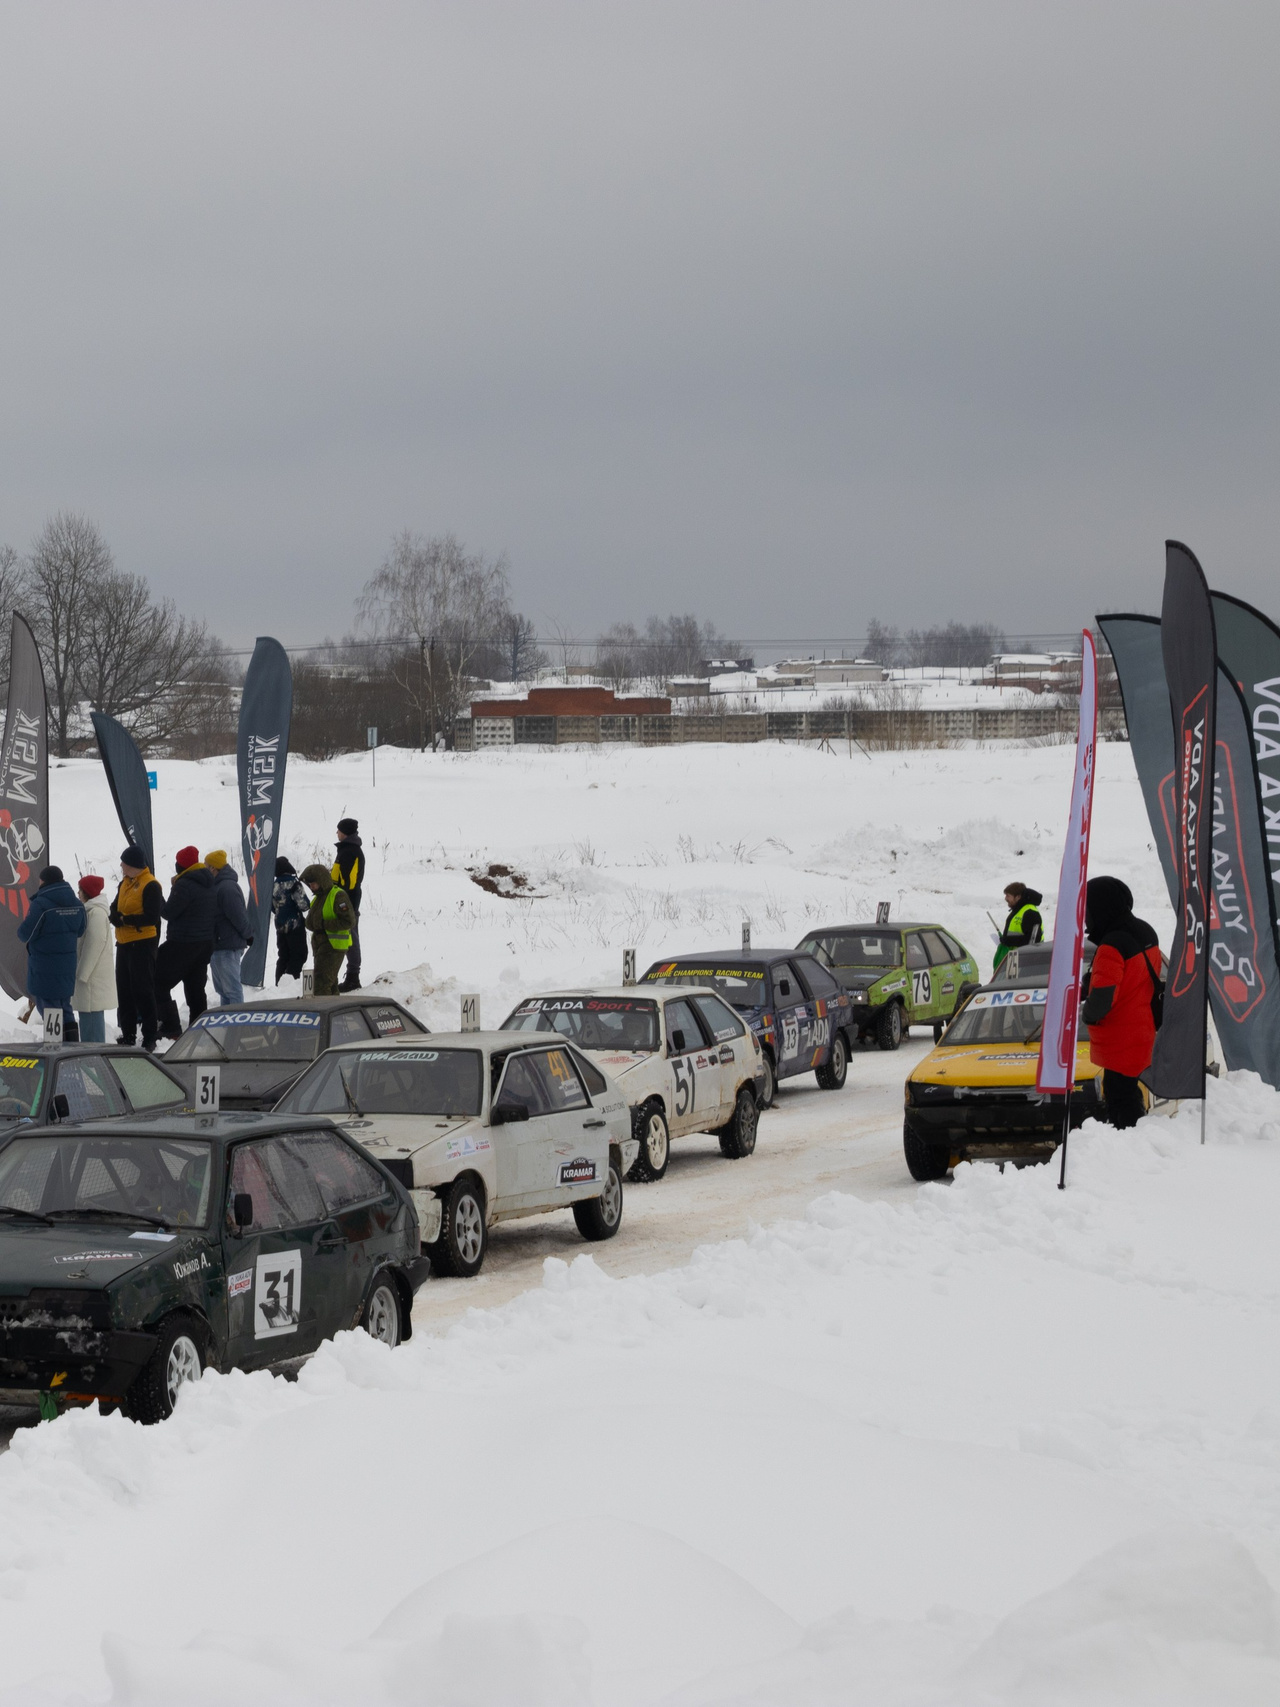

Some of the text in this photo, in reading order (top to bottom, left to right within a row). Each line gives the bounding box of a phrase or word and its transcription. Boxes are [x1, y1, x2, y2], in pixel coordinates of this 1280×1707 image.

[878, 902, 889, 923] 79
[742, 929, 750, 944] 13
[624, 951, 636, 980] 51
[647, 969, 764, 979] FUTURE CHAMPIONS RACING TEAM
[303, 975, 313, 991] 70
[913, 971, 931, 1004] 79
[991, 989, 1048, 1005] Mob
[462, 998, 476, 1024] 41
[541, 1001, 584, 1011] LADA
[586, 1001, 633, 1011] Sport
[45, 1013, 61, 1036] 46
[192, 1012, 321, 1028] ЛУХОВИЦЫ
[376, 1018, 402, 1031] KRAMAR
[785, 1028, 797, 1050] 13
[0, 1056, 39, 1070] Sport
[200, 1075, 216, 1105] 31
[671, 1056, 695, 1117] 51
[563, 1167, 593, 1179] KRAMAR
[62, 1253, 133, 1261] KRAMAR
[264, 1268, 294, 1319] 31
